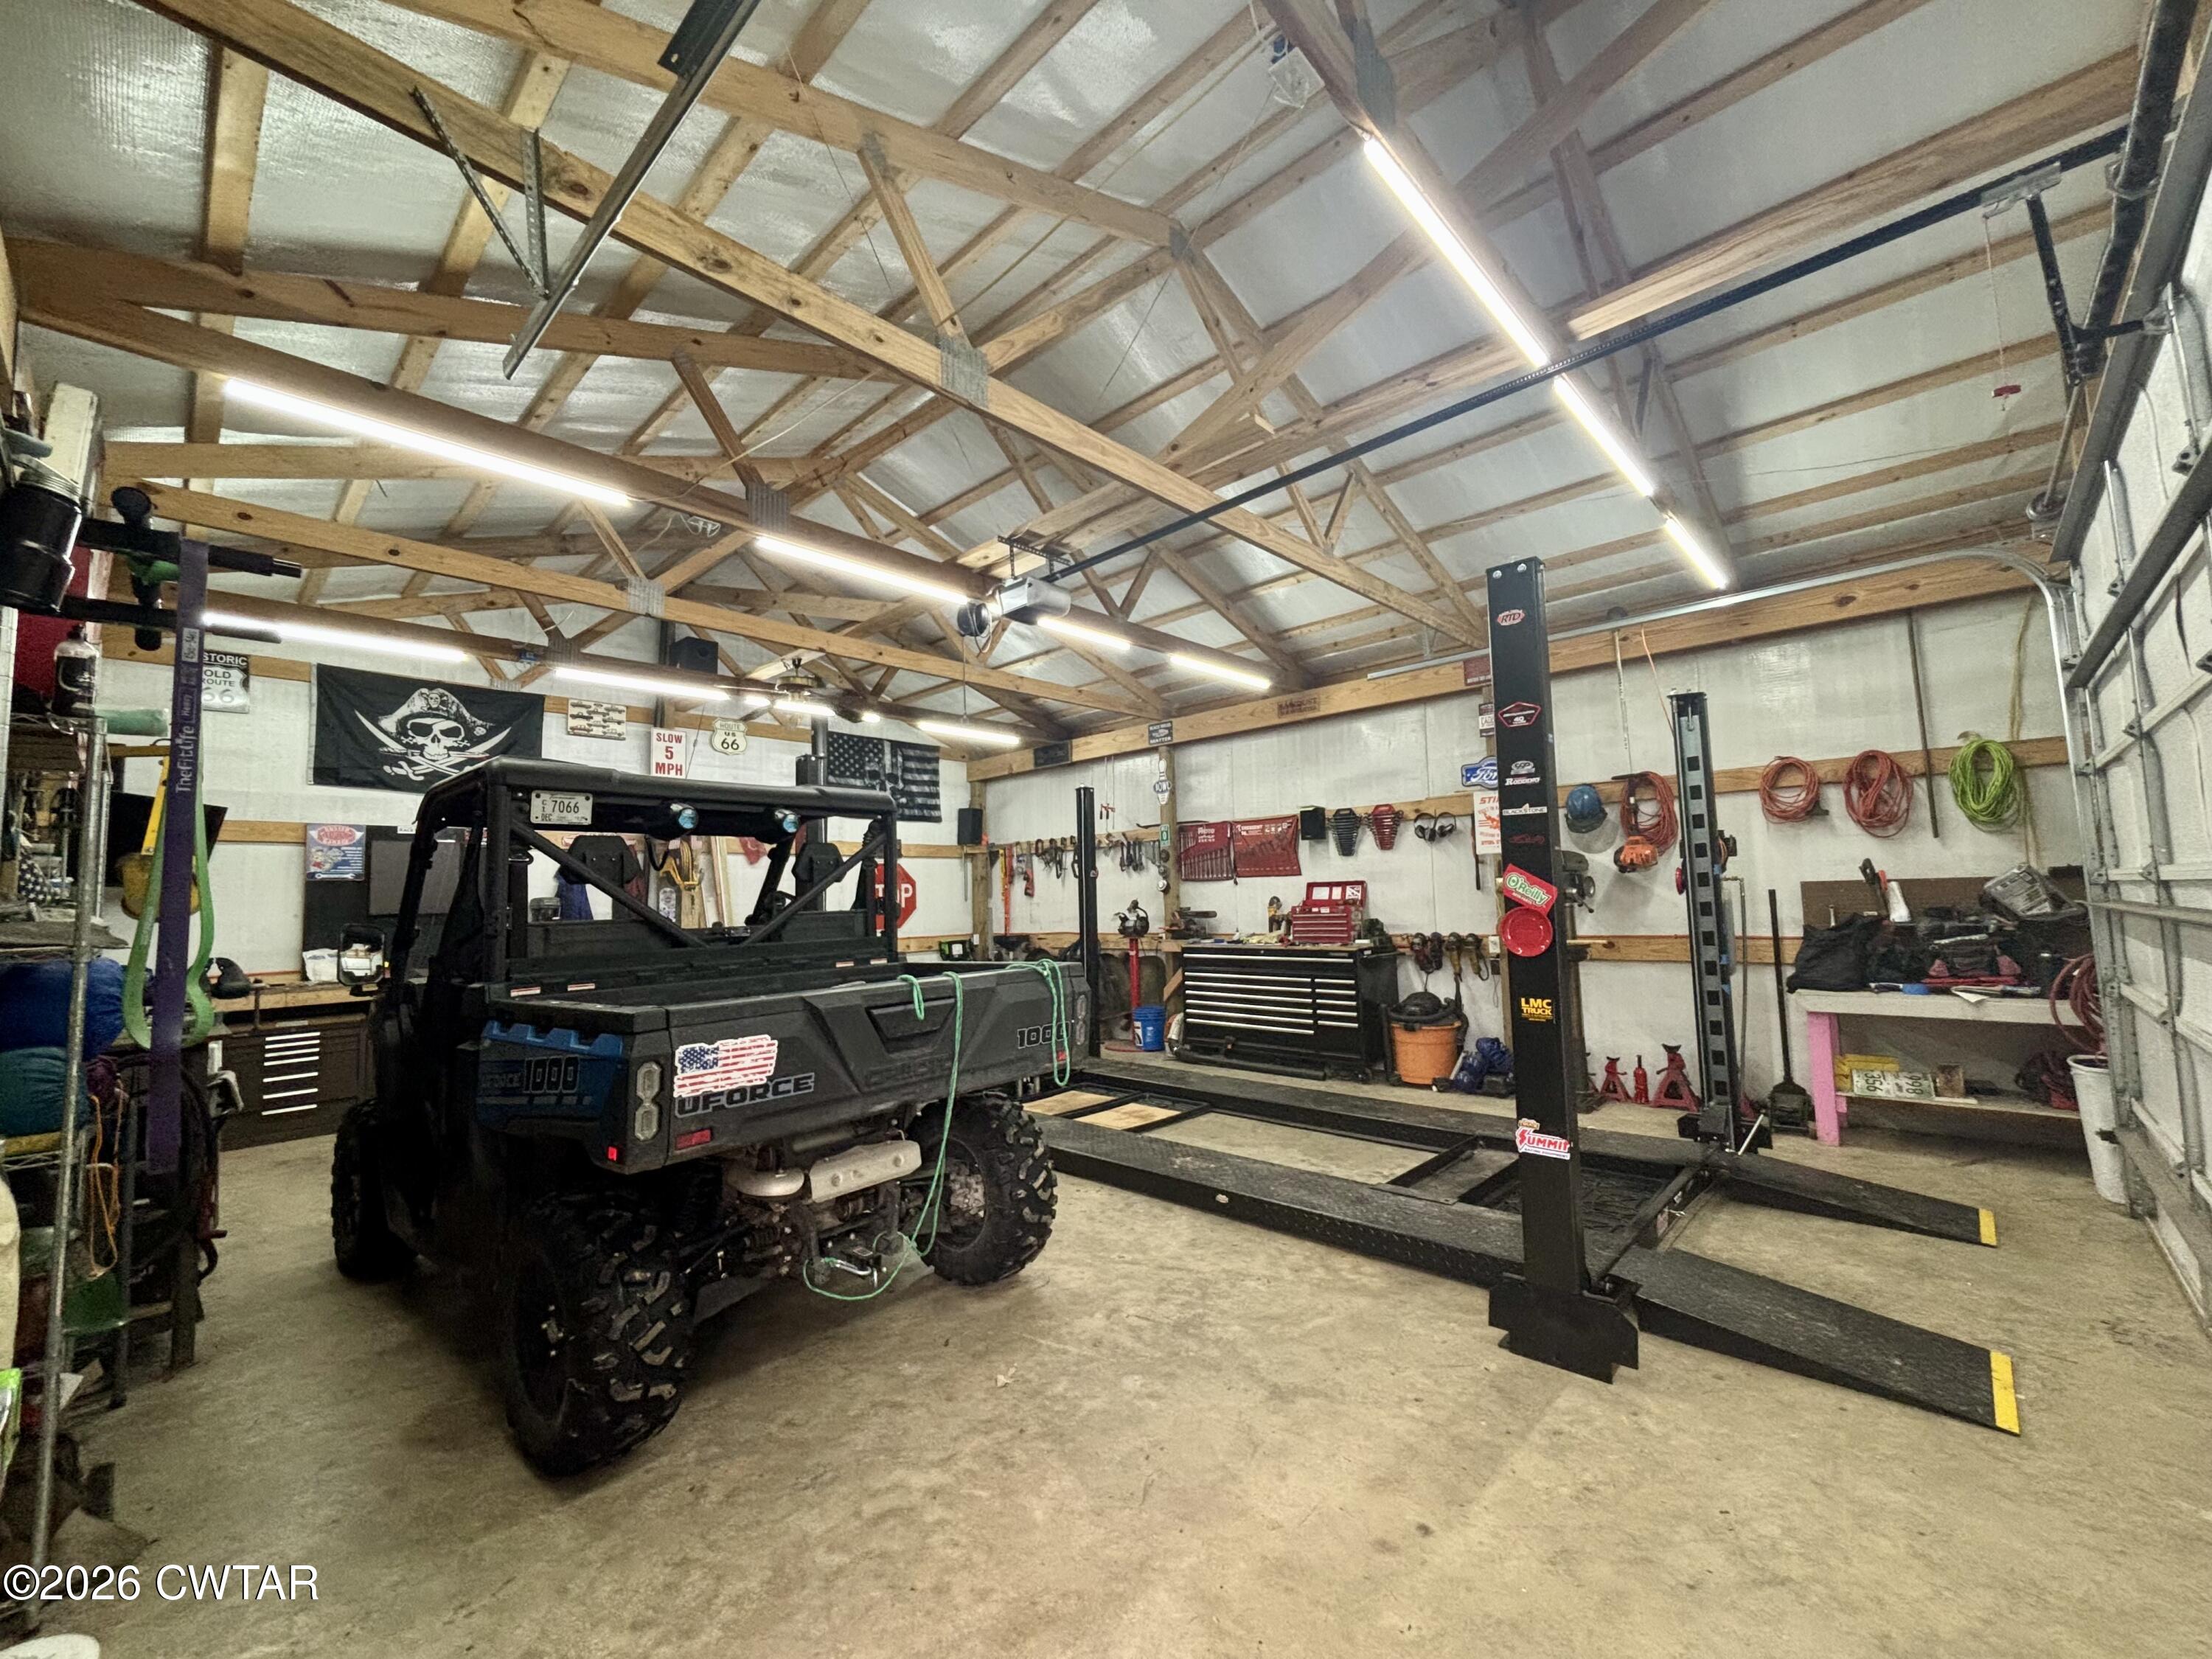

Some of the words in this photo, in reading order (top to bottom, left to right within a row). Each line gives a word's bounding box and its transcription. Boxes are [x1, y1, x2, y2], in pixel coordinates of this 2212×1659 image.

[203, 653, 248, 666] STORIC
[204, 669, 232, 679] OLD
[655, 732, 683, 744] SLOW
[721, 738, 740, 751] 66
[664, 745, 674, 760] 5
[655, 762, 683, 776] MPH
[1470, 766, 1498, 783] For
[551, 800, 580, 813] 7066
[1479, 796, 1499, 805] STI
[1506, 874, 1551, 904] O'Reilly
[1521, 998, 1552, 1009] LMC
[1522, 1007, 1552, 1015] TRUCK
[1017, 1020, 1071, 1049] 1000
[524, 1054, 580, 1093] 1000
[674, 1072, 815, 1118] UFORCE
[1518, 1129, 1570, 1151] SUMMIT
